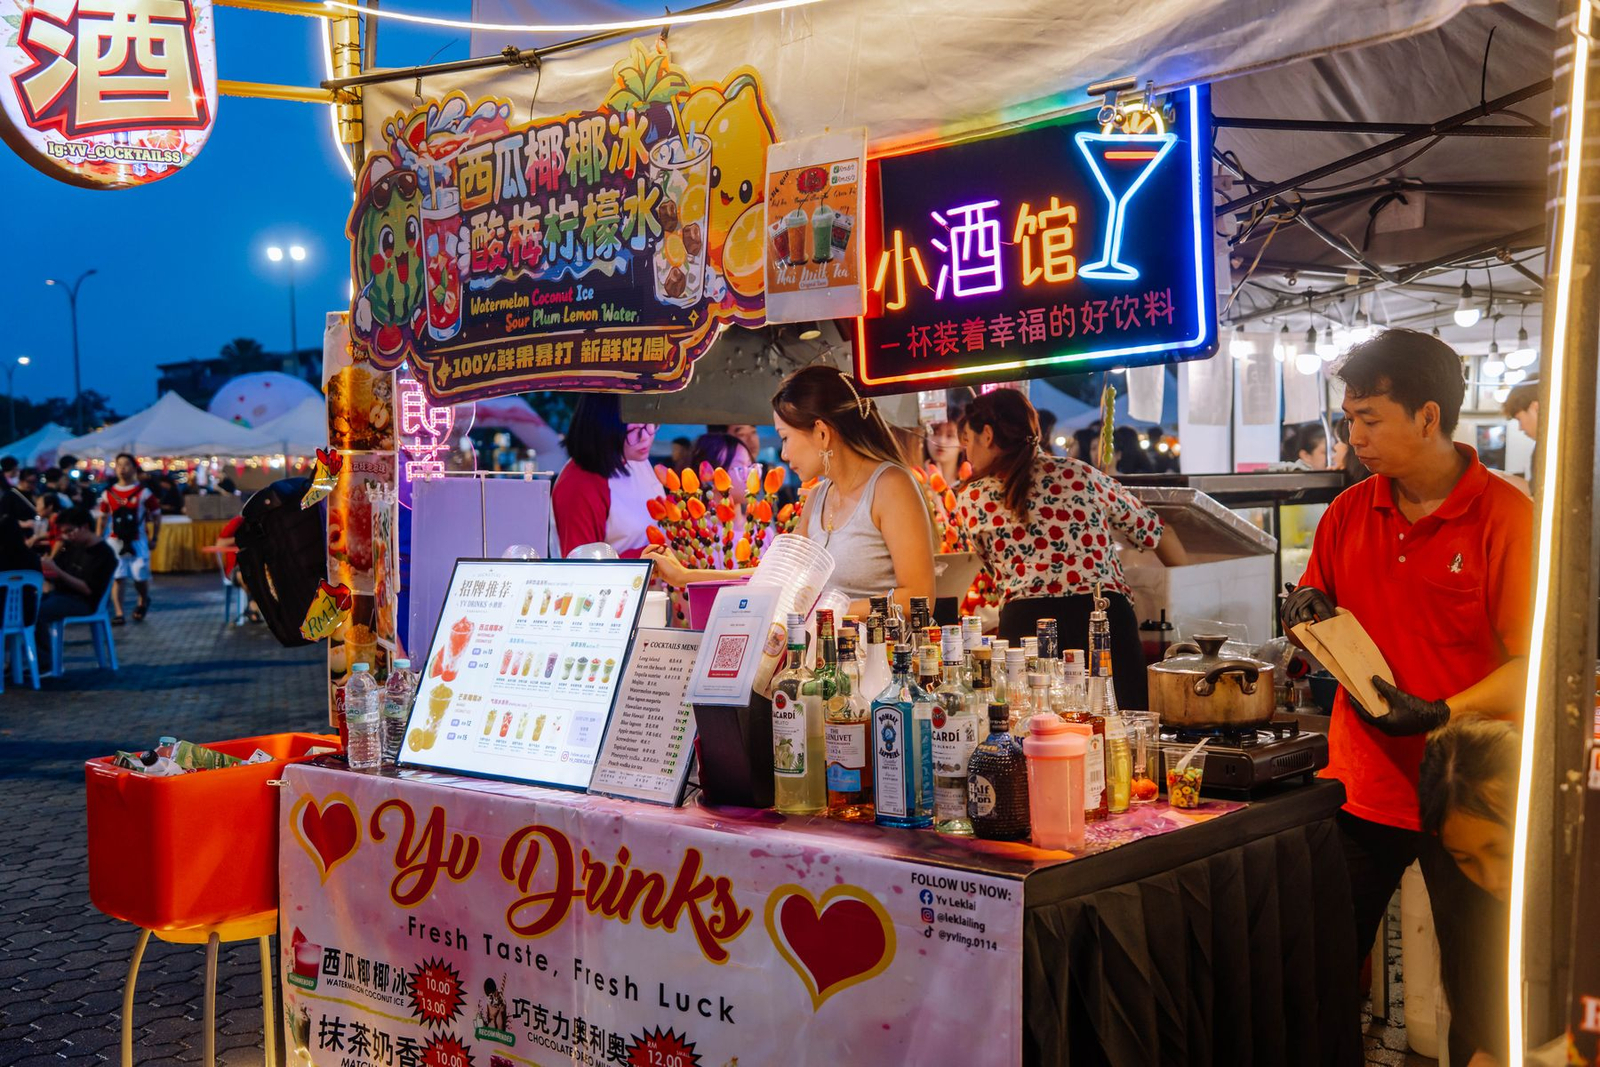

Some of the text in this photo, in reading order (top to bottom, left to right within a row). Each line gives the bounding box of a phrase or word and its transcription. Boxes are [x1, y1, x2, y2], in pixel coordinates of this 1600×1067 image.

[11, 0, 210, 139] 酒
[458, 109, 649, 211] 西瓜椰椰冰
[469, 177, 662, 273] 酸梅柠檬水
[872, 196, 1078, 311] 小酒馆
[470, 284, 594, 316] Watermelon Coconut Ice
[505, 313, 530, 333] Sour
[532, 309, 560, 328] Plum
[563, 306, 599, 323] Lemon
[880, 287, 1176, 358] 一杯装着幸福的好饮料
[451, 336, 665, 379] 100%鲜果暴打 新鲜好喝
[459, 579, 512, 598] 招牌推荐
[650, 641, 699, 652] COCKTAILS MENU
[931, 728, 960, 742] CARDÍ
[500, 825, 752, 965] Drinks
[911, 872, 1012, 901] FOLLOW US NOW:
[949, 897, 977, 911] Leklai
[937, 912, 986, 933] @leklailing
[938, 930, 998, 951] @yvling.0114
[322, 947, 410, 996] 西瓜椰椰冰
[408, 916, 736, 1024] Fresh Taste, Fresh Luck
[326, 977, 404, 1007] WATERMELON COCONUT ICE
[426, 977, 450, 995] 10.00
[422, 997, 446, 1016] 13.00
[318, 1013, 421, 1067] 抹茶奶香
[511, 998, 630, 1067] 巧克力奥利奥
[527, 1031, 573, 1058] CHOCOLATE
[647, 1041, 657, 1049] RM
[436, 1050, 463, 1067] 10.00
[648, 1049, 690, 1067] 12.00 SMALL
